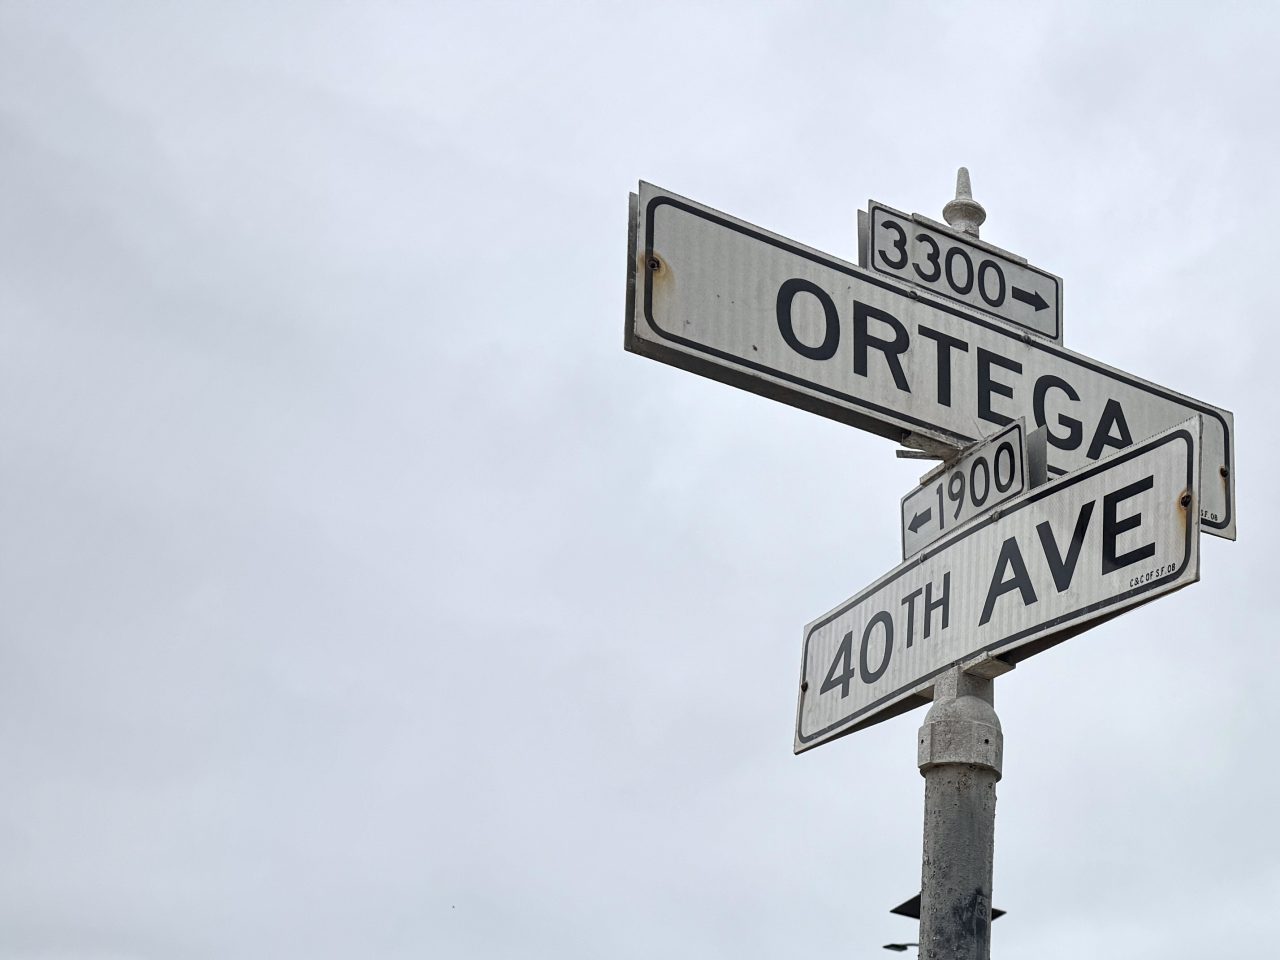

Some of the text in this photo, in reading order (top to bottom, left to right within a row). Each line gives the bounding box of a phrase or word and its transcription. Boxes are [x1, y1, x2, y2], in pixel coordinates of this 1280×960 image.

[877, 219, 1006, 308] 3300
[776, 277, 1134, 461] ORTEGA
[936, 441, 1016, 530] 1900
[820, 474, 1156, 699] 40TH AVE
[1129, 574, 1144, 588] C&C
[1145, 570, 1154, 582] OF
